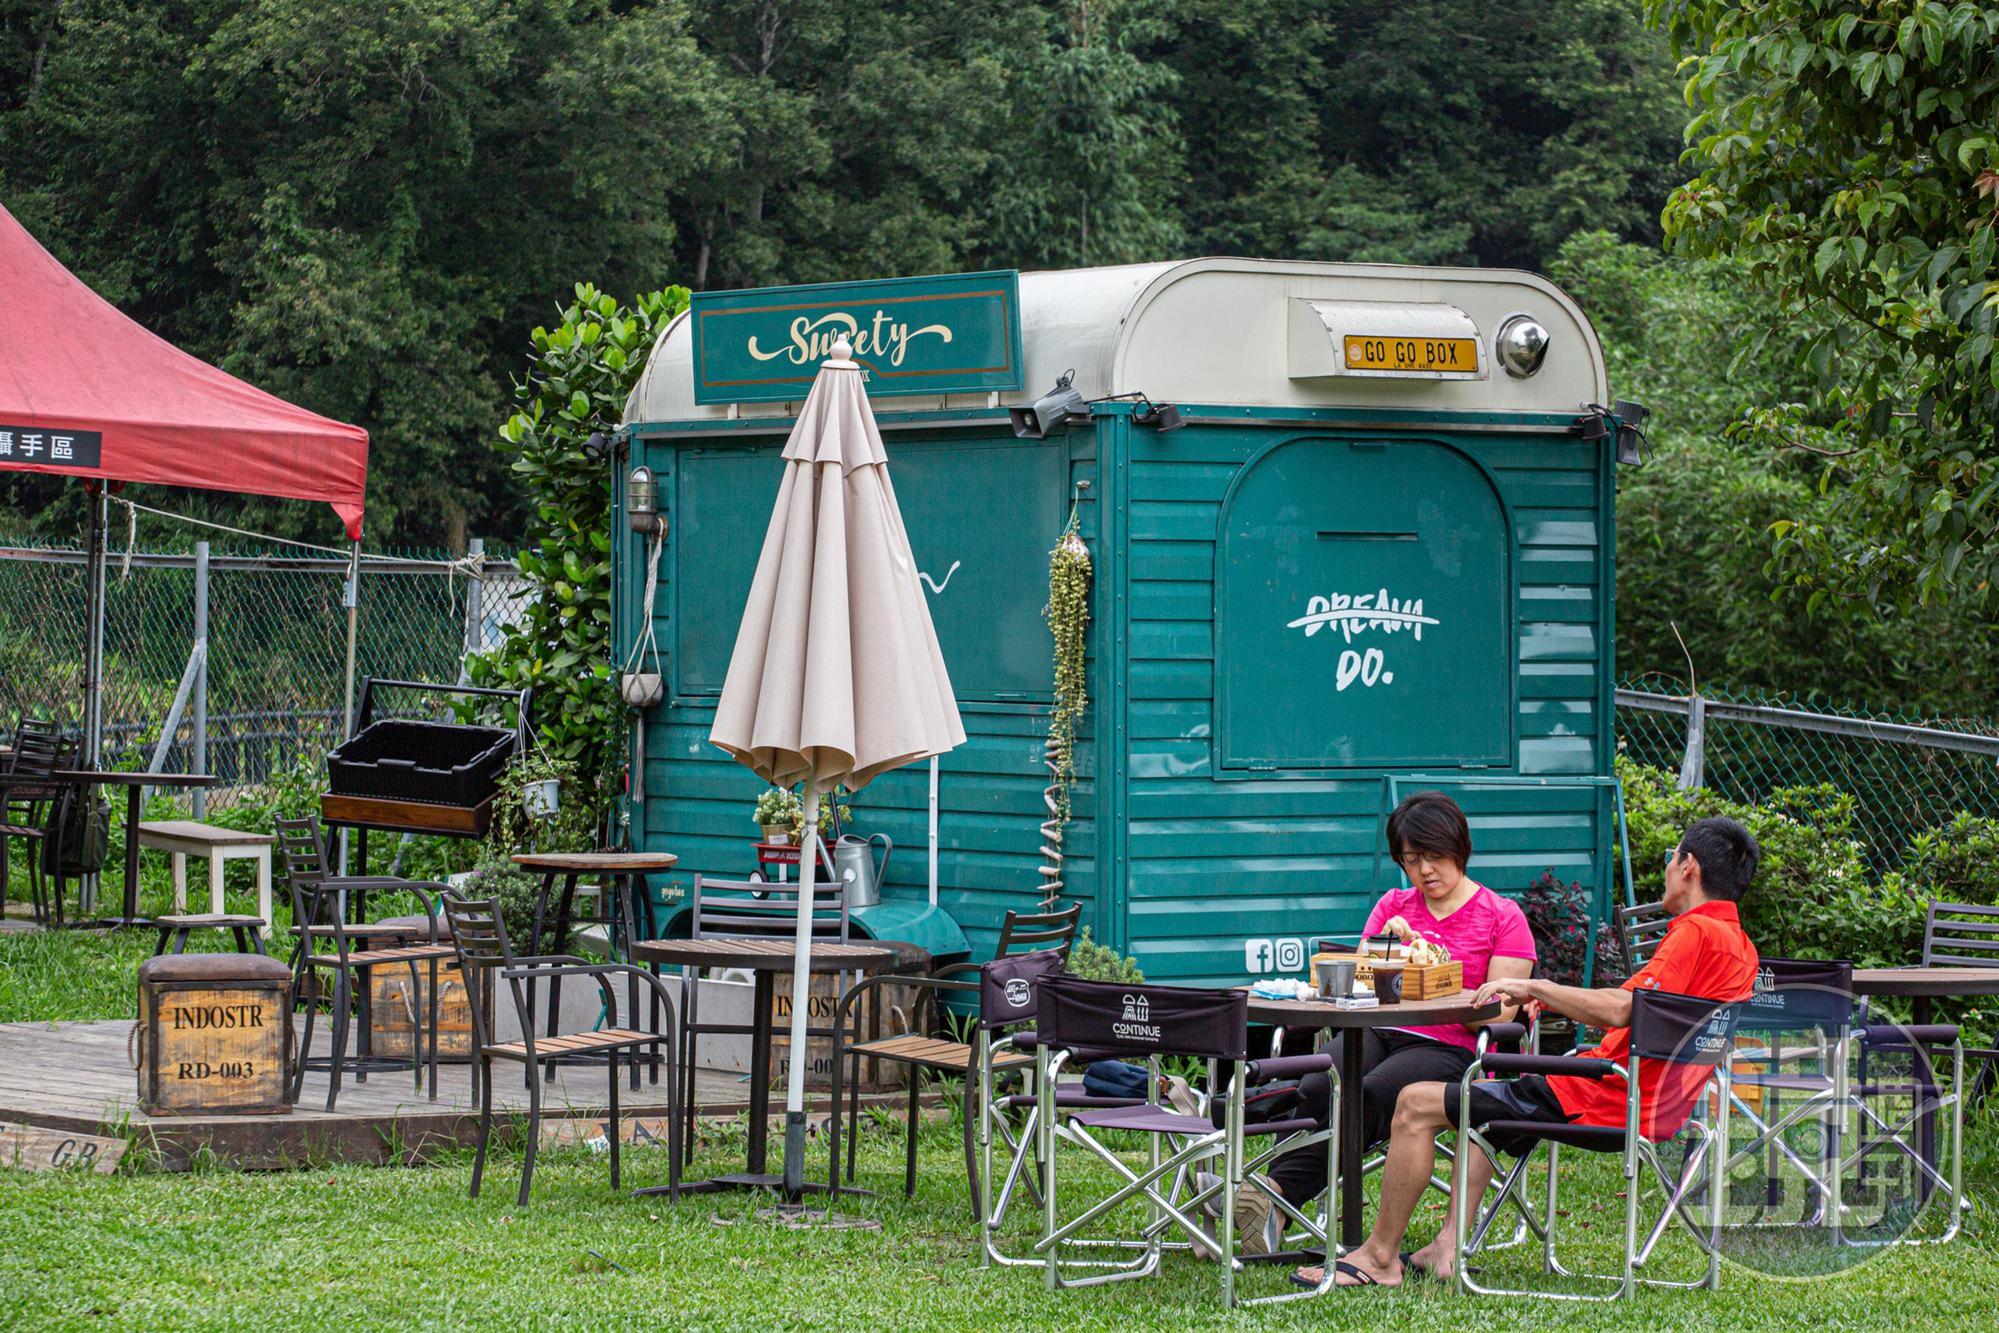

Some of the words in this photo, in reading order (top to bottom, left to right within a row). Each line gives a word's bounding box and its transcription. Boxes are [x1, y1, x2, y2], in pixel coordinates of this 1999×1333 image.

[1365, 340, 1385, 362] GO
[1395, 341, 1416, 363] GO
[1426, 342, 1457, 364] BOX
[1304, 588, 1423, 644] DREAM
[1336, 648, 1393, 691] DO.
[174, 1005, 263, 1029] INDOSTR
[1112, 1023, 1161, 1037] CONTINUE
[178, 1062, 253, 1080] RD-003
